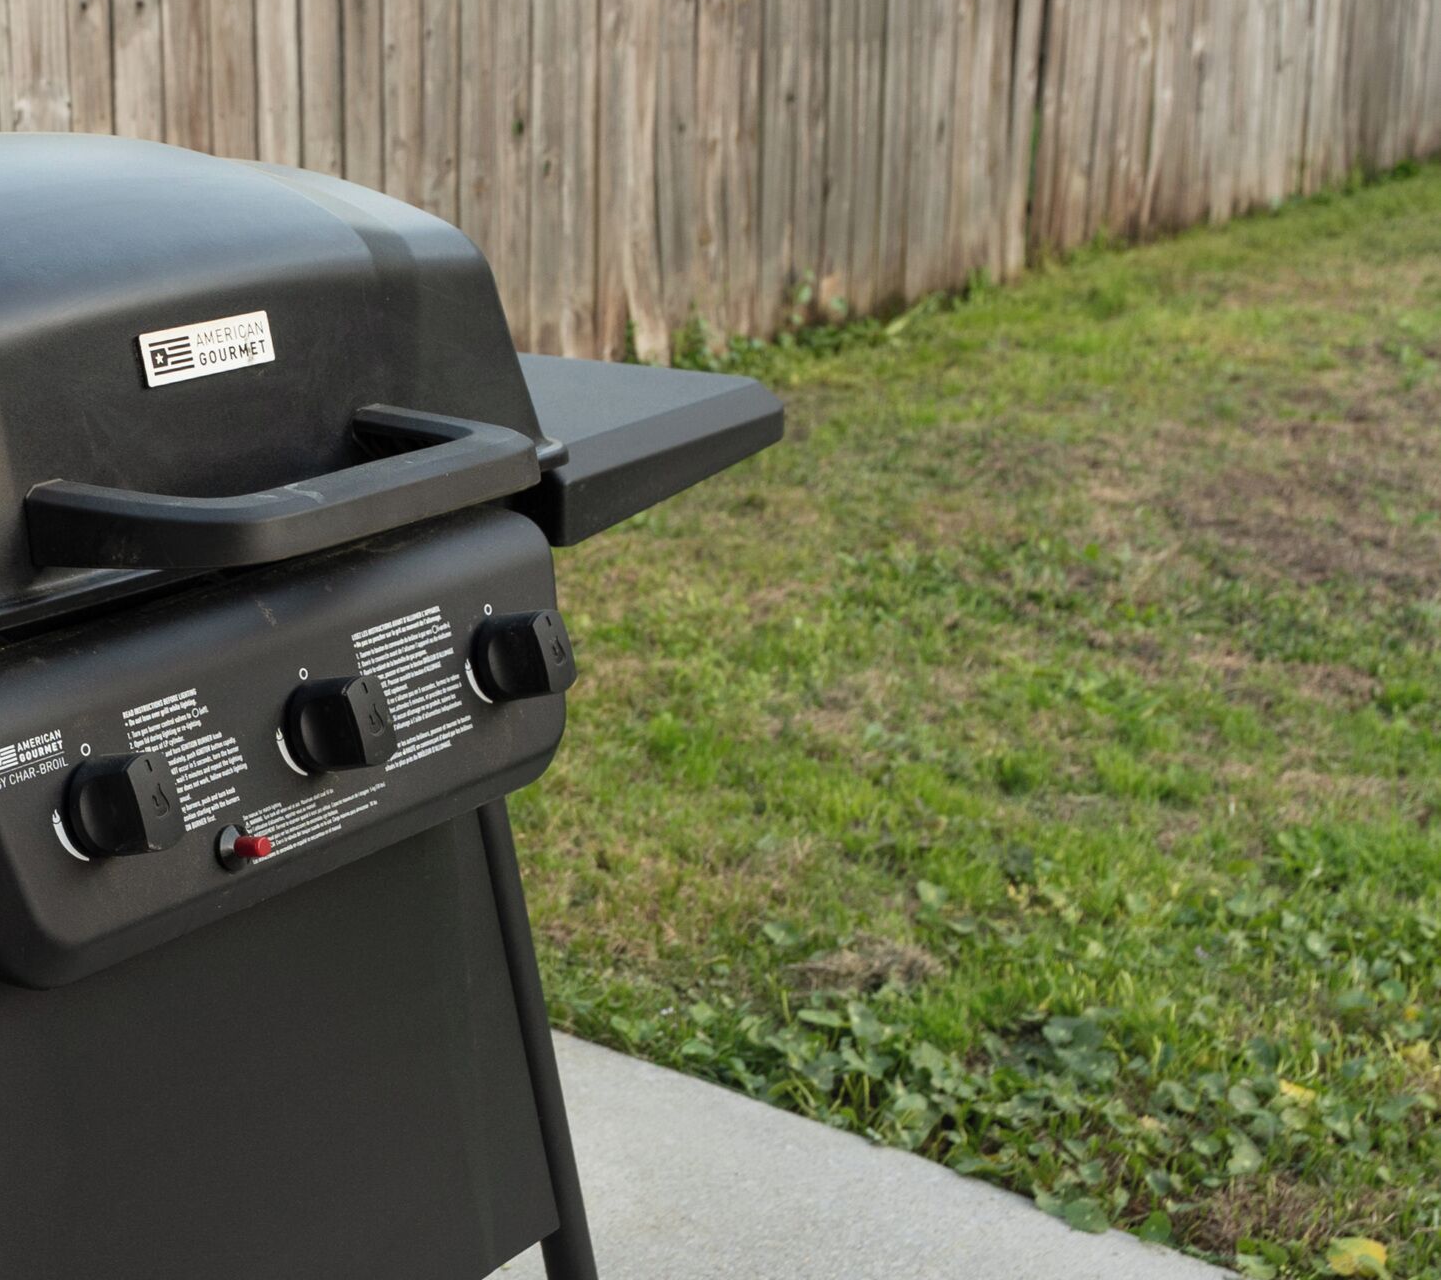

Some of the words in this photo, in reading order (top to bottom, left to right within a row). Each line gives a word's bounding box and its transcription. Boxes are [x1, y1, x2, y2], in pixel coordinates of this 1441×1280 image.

[196, 321, 264, 347] AMERICAN
[199, 340, 266, 366] GOURMET
[17, 729, 62, 752] AMERICAN
[19, 740, 63, 762] GOURMET
[9, 757, 69, 785] CHAR-BROIL
